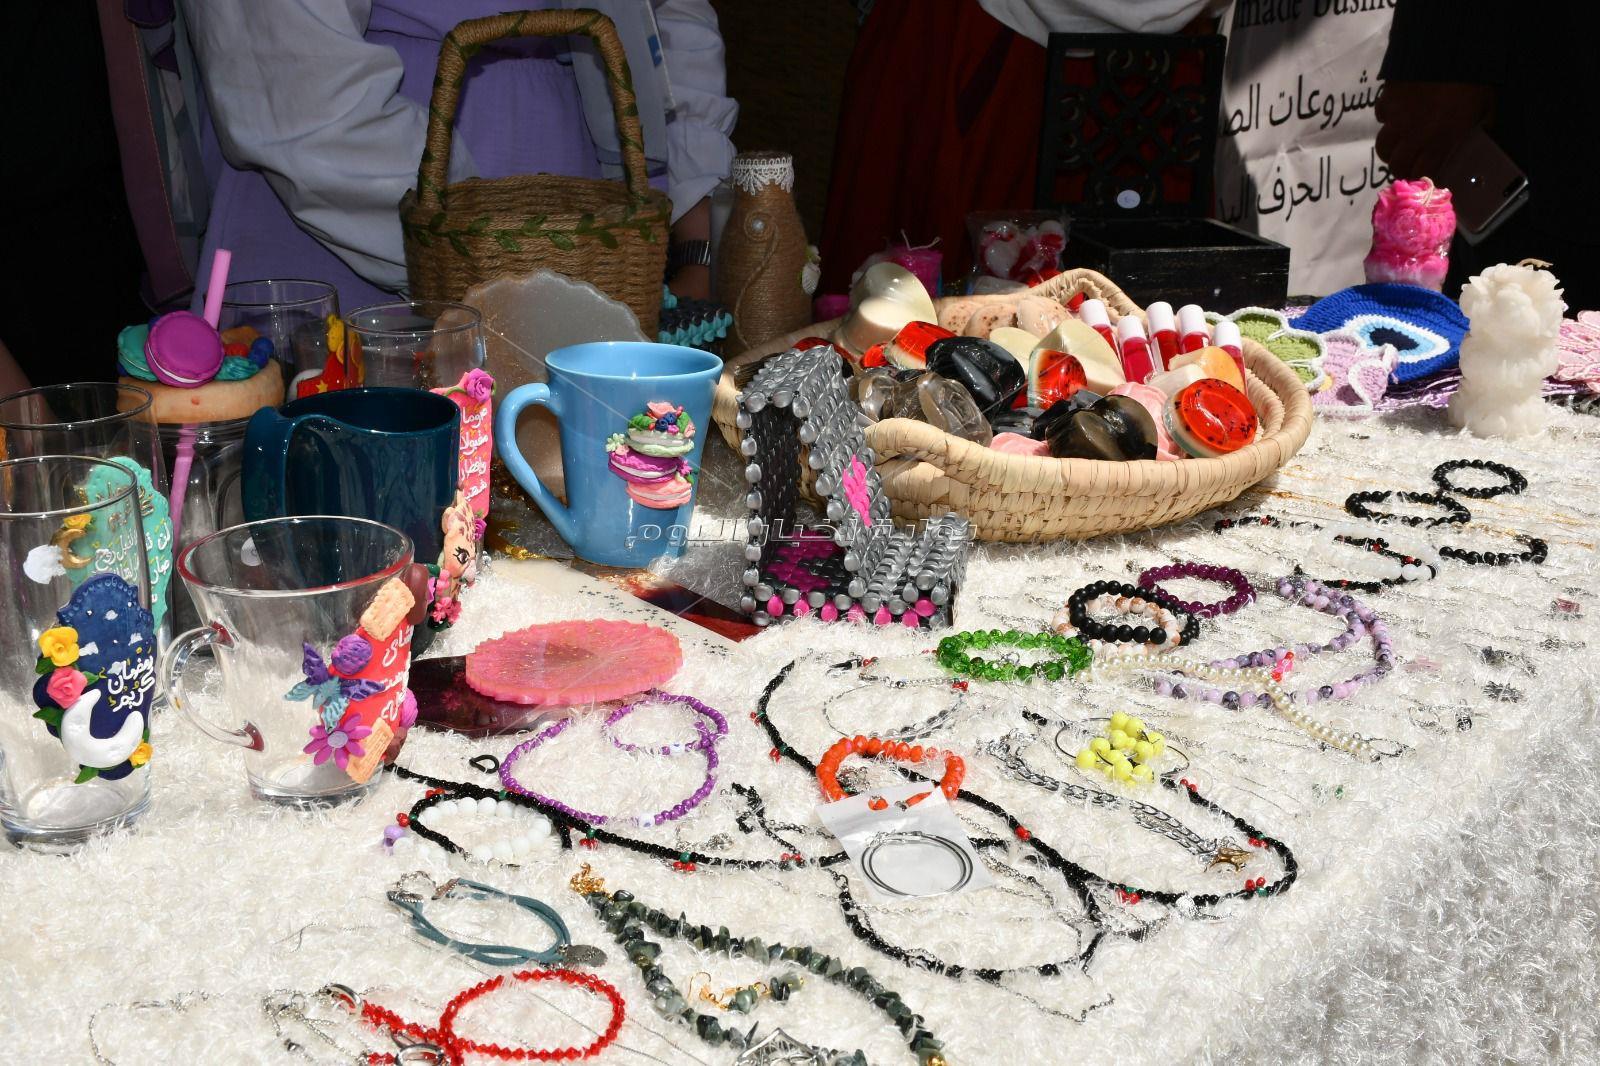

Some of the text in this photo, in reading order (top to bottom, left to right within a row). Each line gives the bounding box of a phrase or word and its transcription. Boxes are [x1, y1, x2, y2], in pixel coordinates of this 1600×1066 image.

[1257, 155, 1331, 222] الحرف
[107, 655, 154, 695] رمضان
[112, 667, 156, 713] كريم
